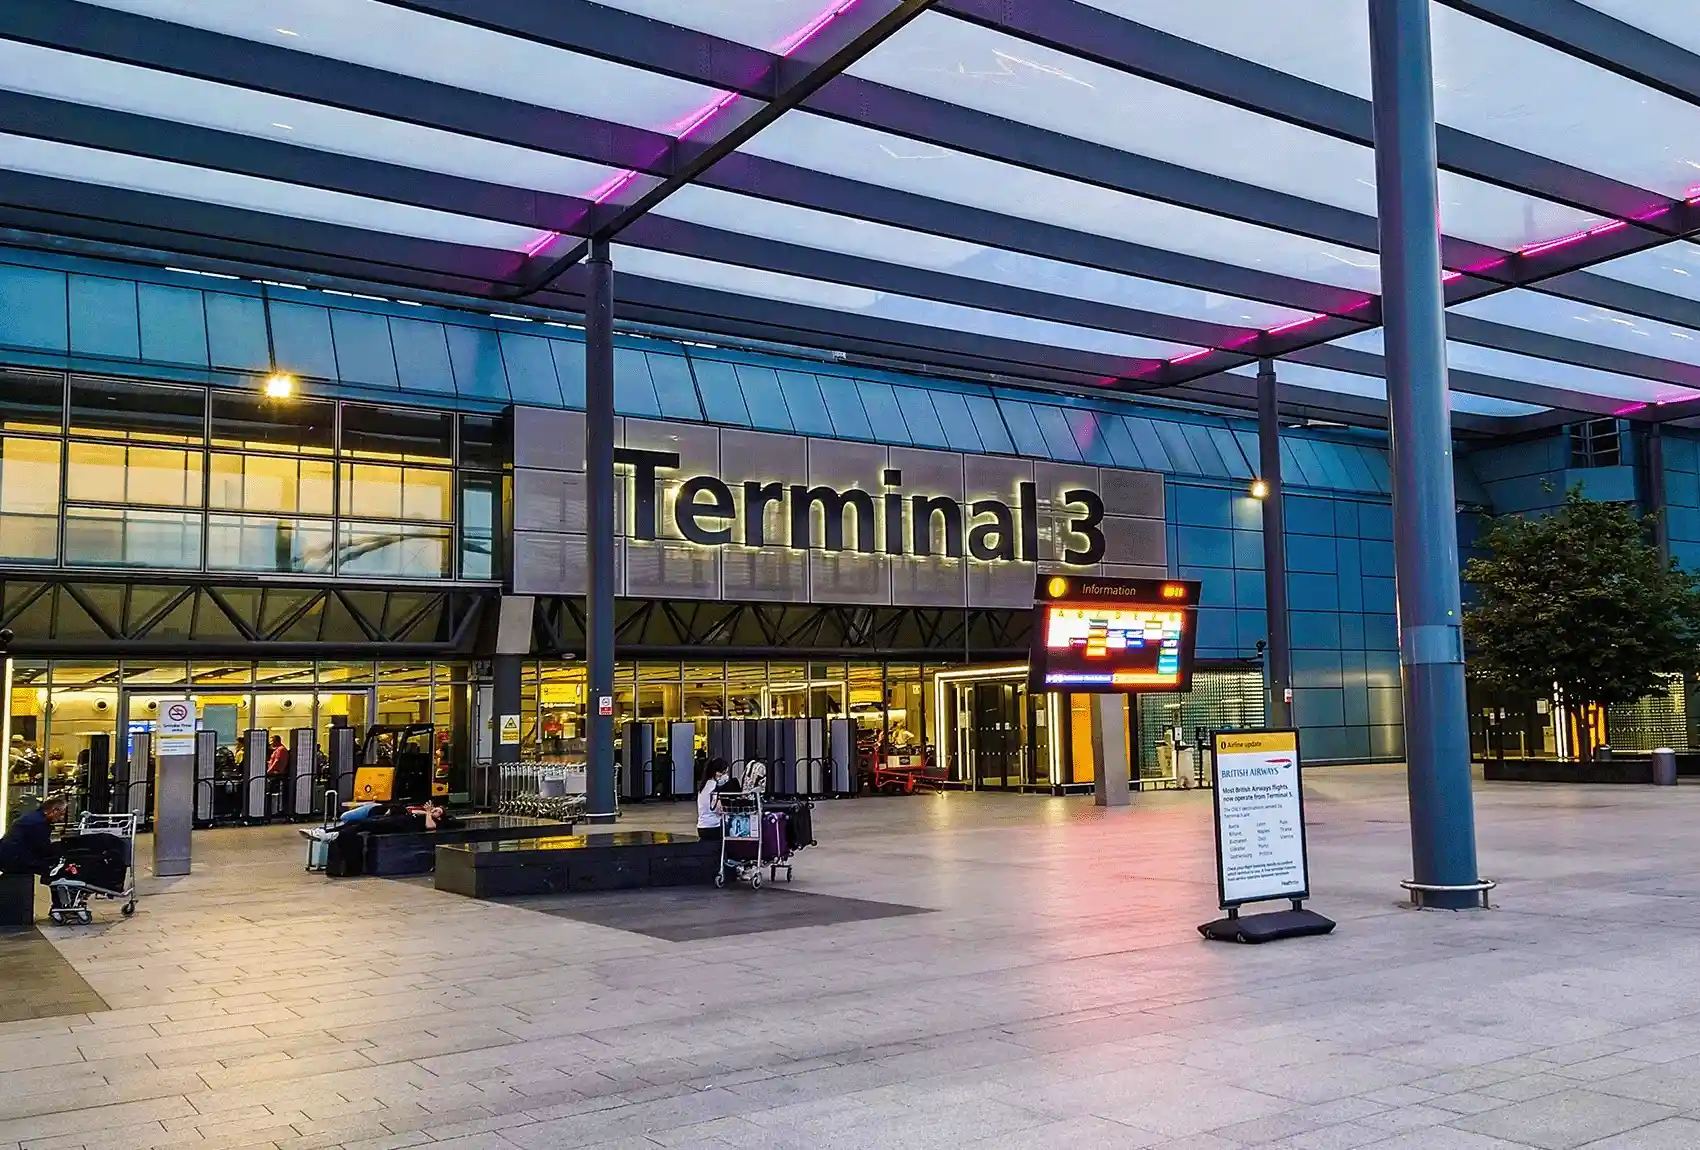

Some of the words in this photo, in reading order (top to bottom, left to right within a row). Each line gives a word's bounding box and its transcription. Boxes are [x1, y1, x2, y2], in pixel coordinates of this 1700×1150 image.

[613, 447, 1037, 562] Terminal
[1064, 488, 1106, 565] 3
[1082, 584, 1136, 596] Information
[1221, 769, 1248, 778] BRITISH
[1249, 767, 1279, 777] AIRWAYS
